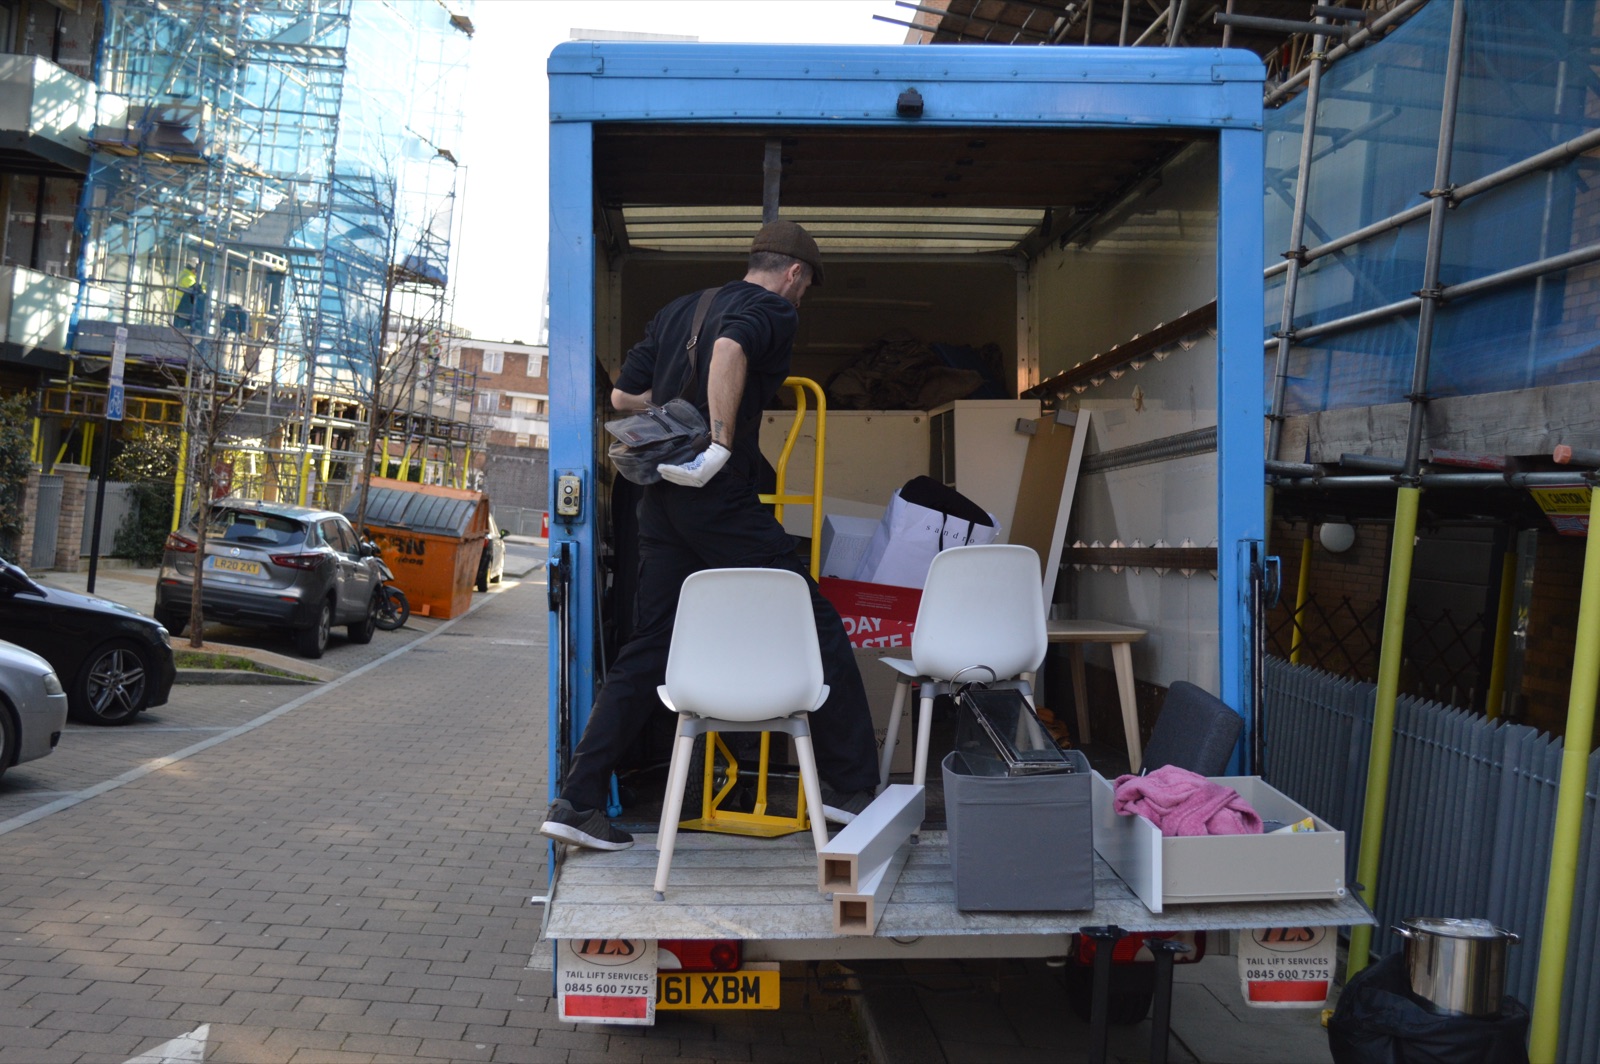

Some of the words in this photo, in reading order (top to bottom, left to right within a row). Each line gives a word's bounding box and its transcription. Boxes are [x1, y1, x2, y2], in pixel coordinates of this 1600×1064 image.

[926, 525, 975, 544] sandro
[566, 971, 584, 979] TAIL
[587, 972, 605, 980] LIFT
[607, 972, 649, 981] SERVICES
[1247, 970, 1275, 979] 0845
[1278, 969, 1299, 979] 600
[1302, 969, 1329, 979] 7575
[564, 983, 592, 993] 0845
[595, 984, 617, 994] 600
[620, 985, 648, 995] 7575
[701, 976, 760, 1004] XBM
